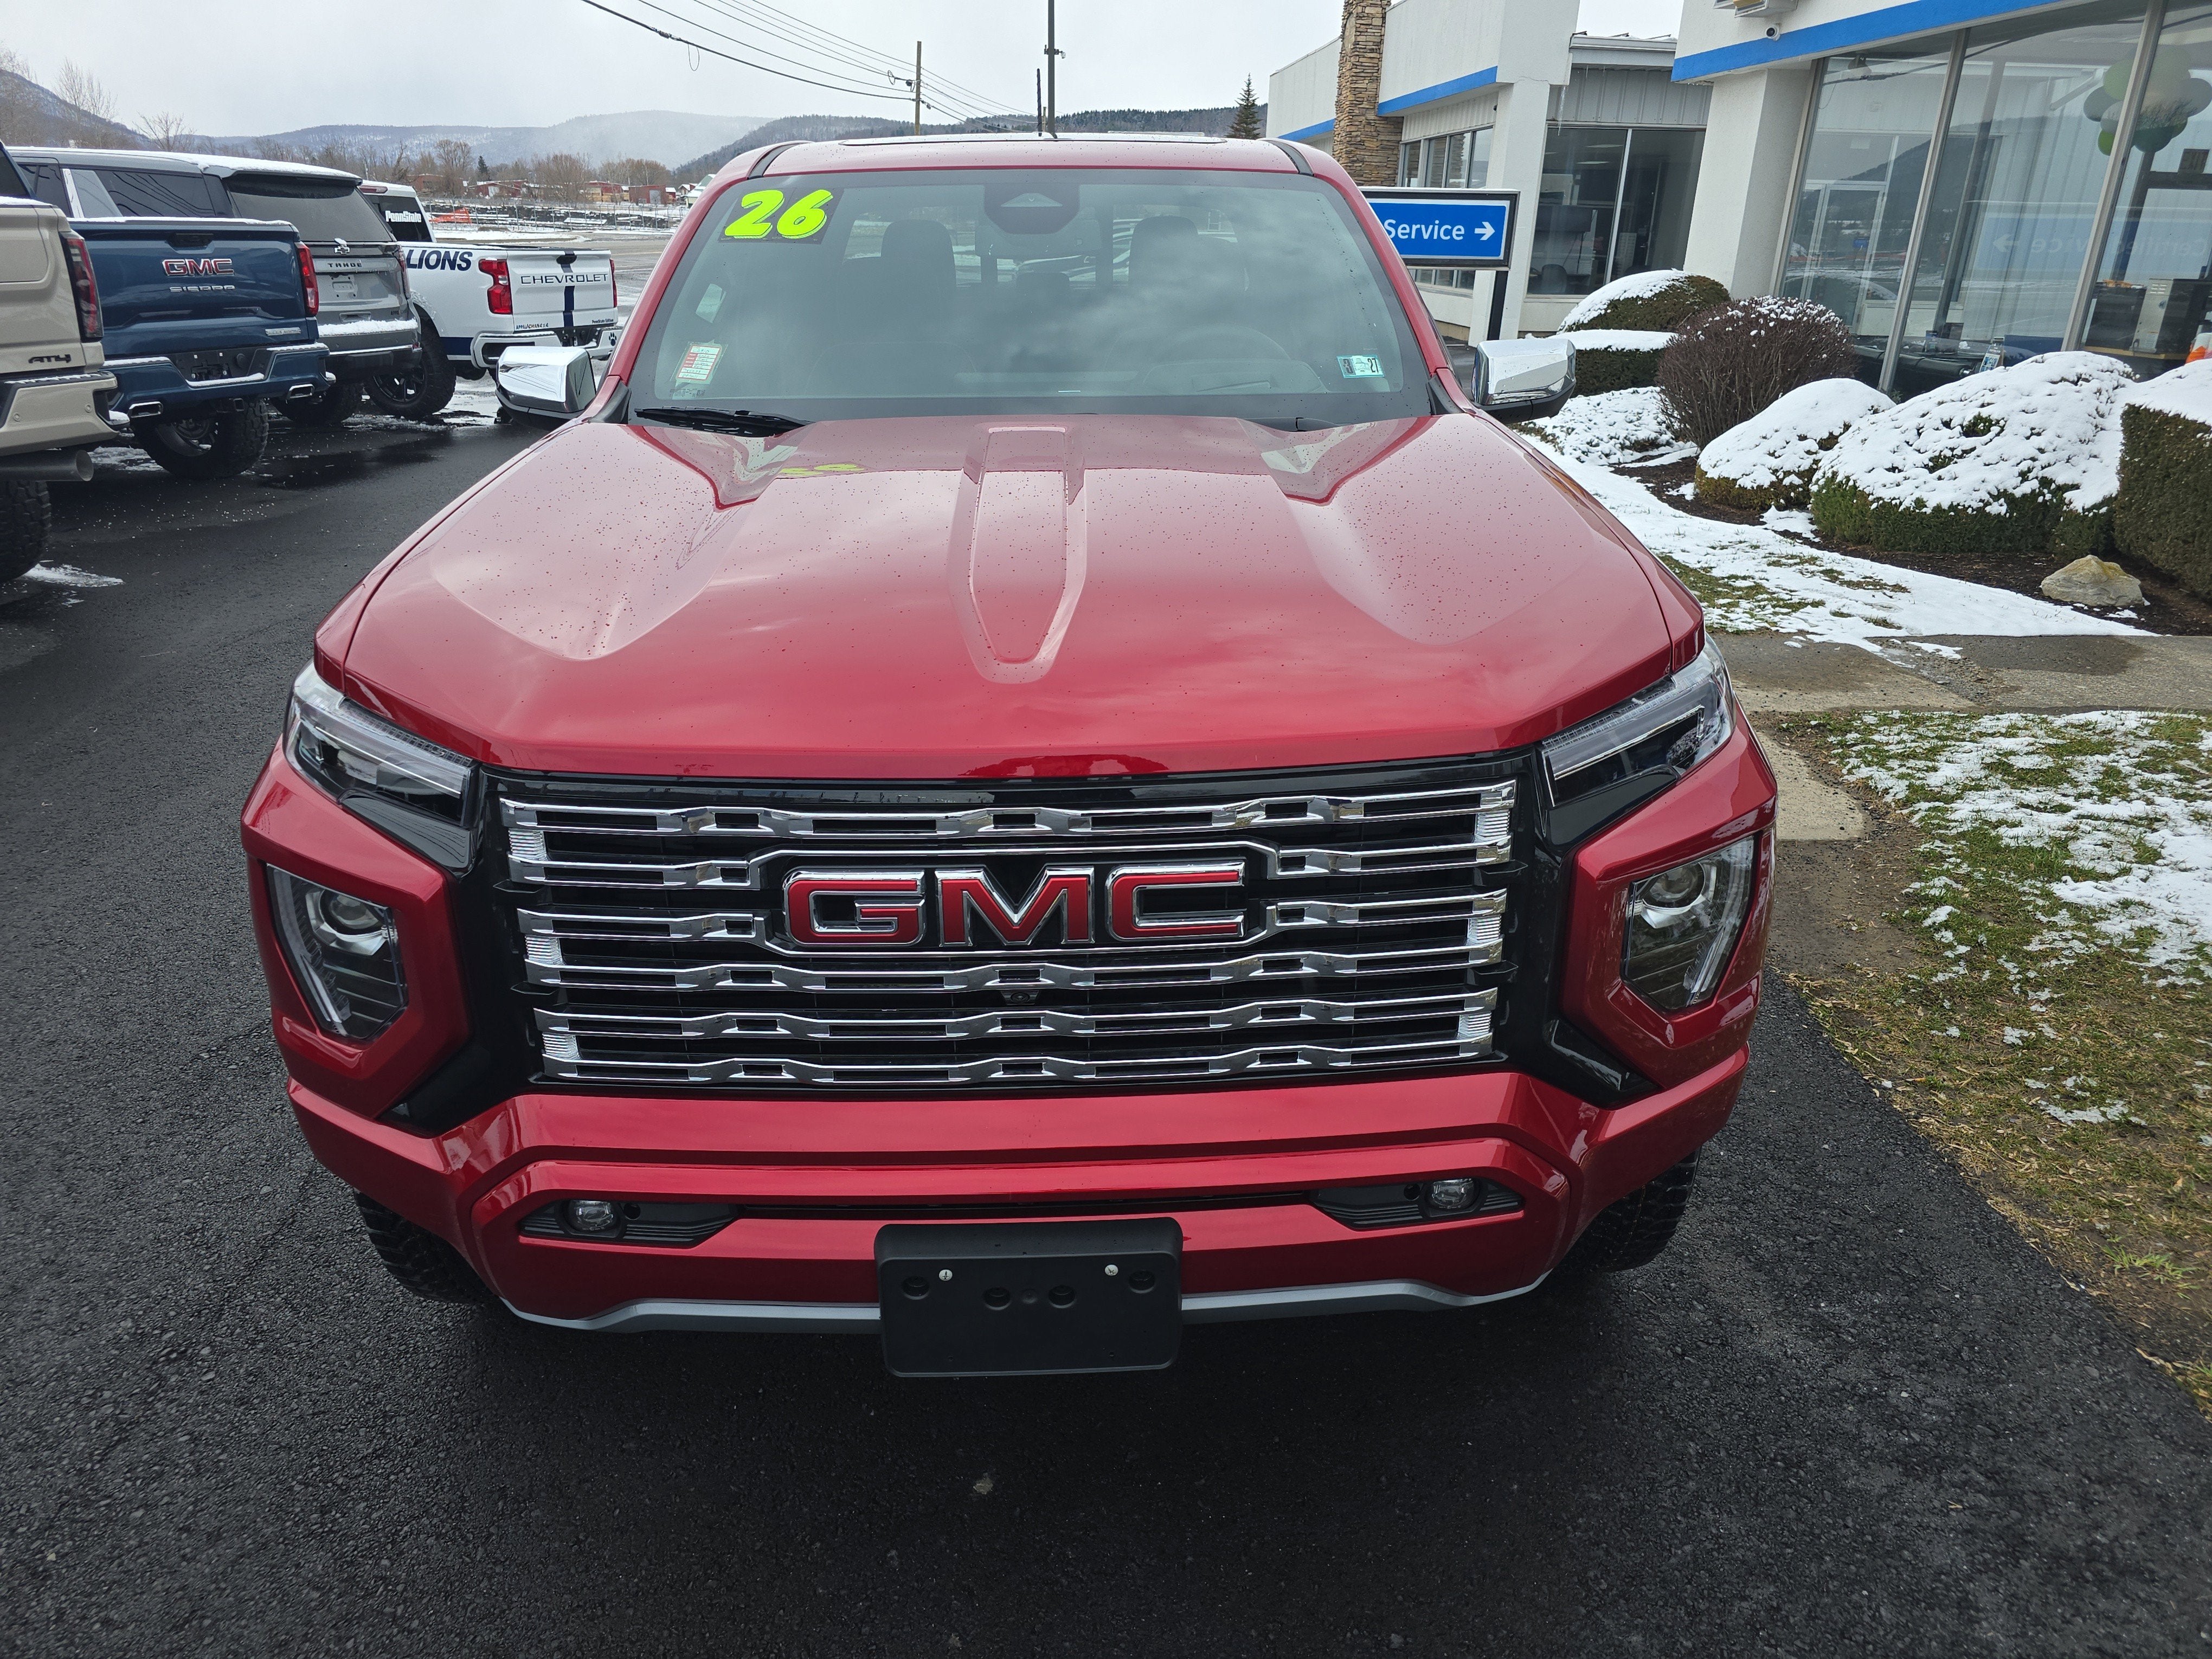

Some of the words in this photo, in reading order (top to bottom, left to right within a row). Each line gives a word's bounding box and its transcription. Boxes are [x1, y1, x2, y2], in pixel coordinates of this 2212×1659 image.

[725, 190, 833, 239] 26
[1384, 219, 1465, 240] Service
[162, 259, 235, 277] GMC
[407, 249, 473, 271] LIONS
[521, 274, 608, 284] CHEVROLET
[28, 354, 72, 363] AT4
[1343, 358, 1353, 374] 3
[1367, 358, 1379, 374] 27
[783, 861, 1246, 947] GMC
